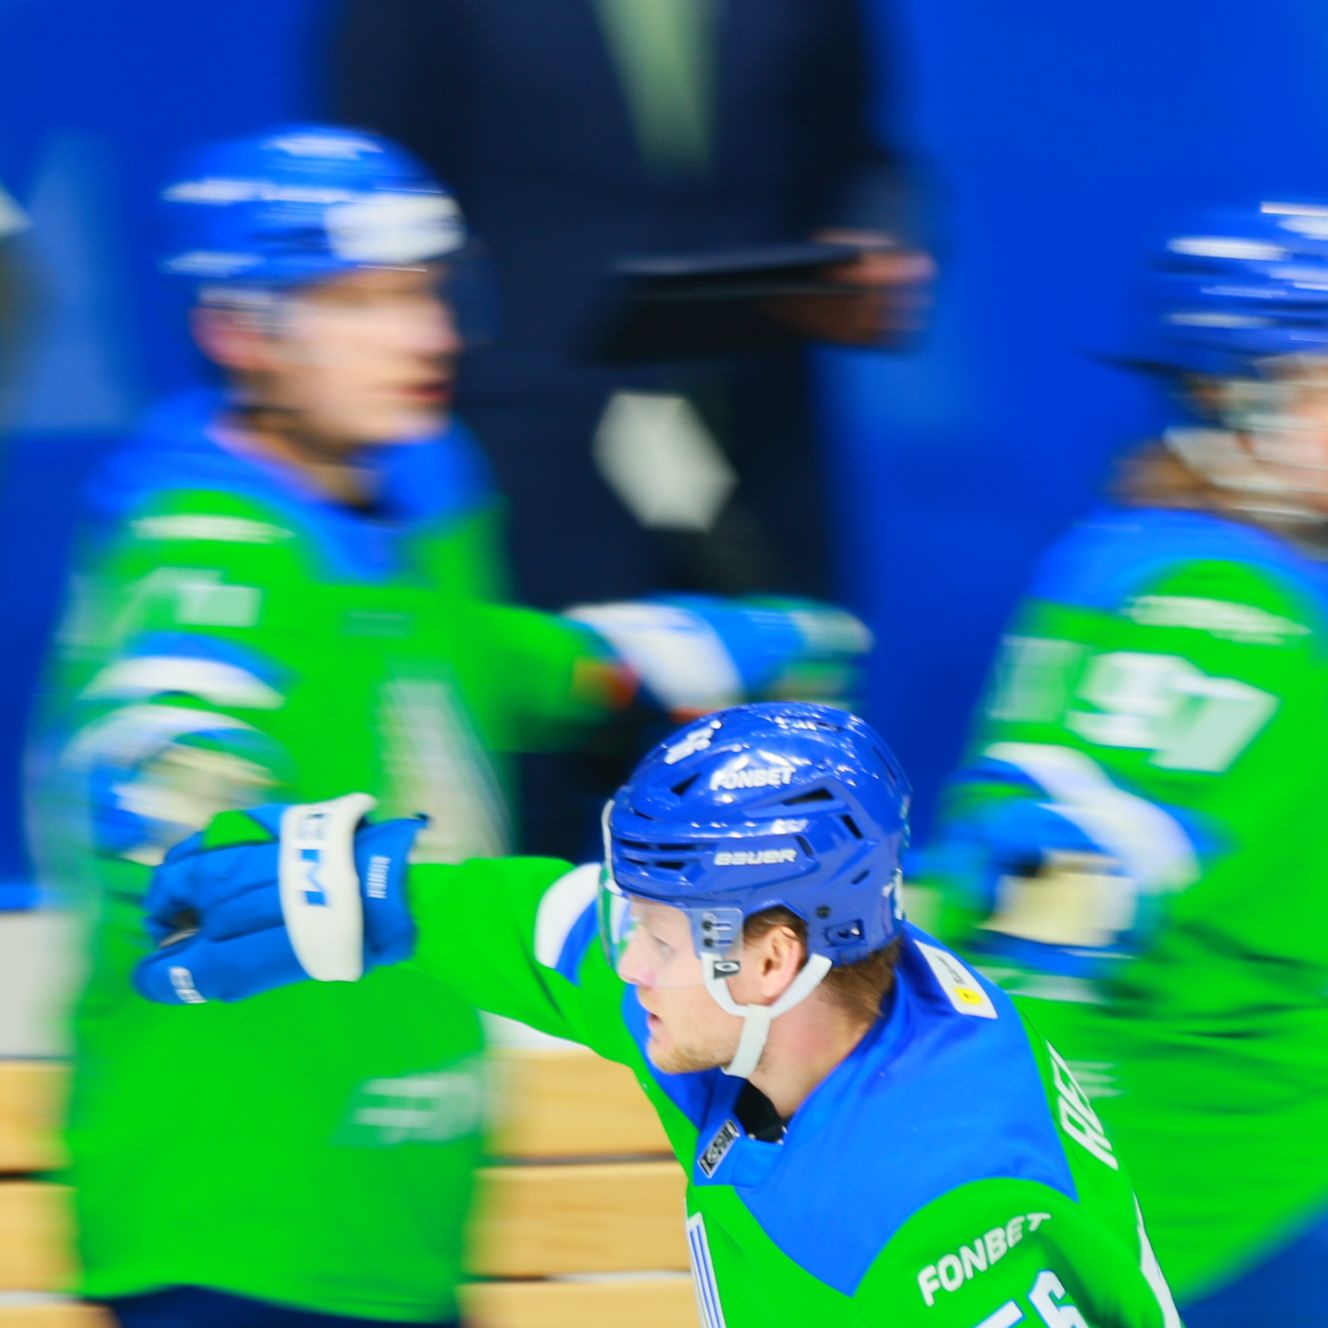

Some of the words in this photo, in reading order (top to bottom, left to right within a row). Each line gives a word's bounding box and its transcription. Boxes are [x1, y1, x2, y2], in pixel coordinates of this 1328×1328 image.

[709, 765, 796, 791] FONBET
[714, 848, 797, 866] BAUER
[917, 1212, 1051, 1307] FONBET
